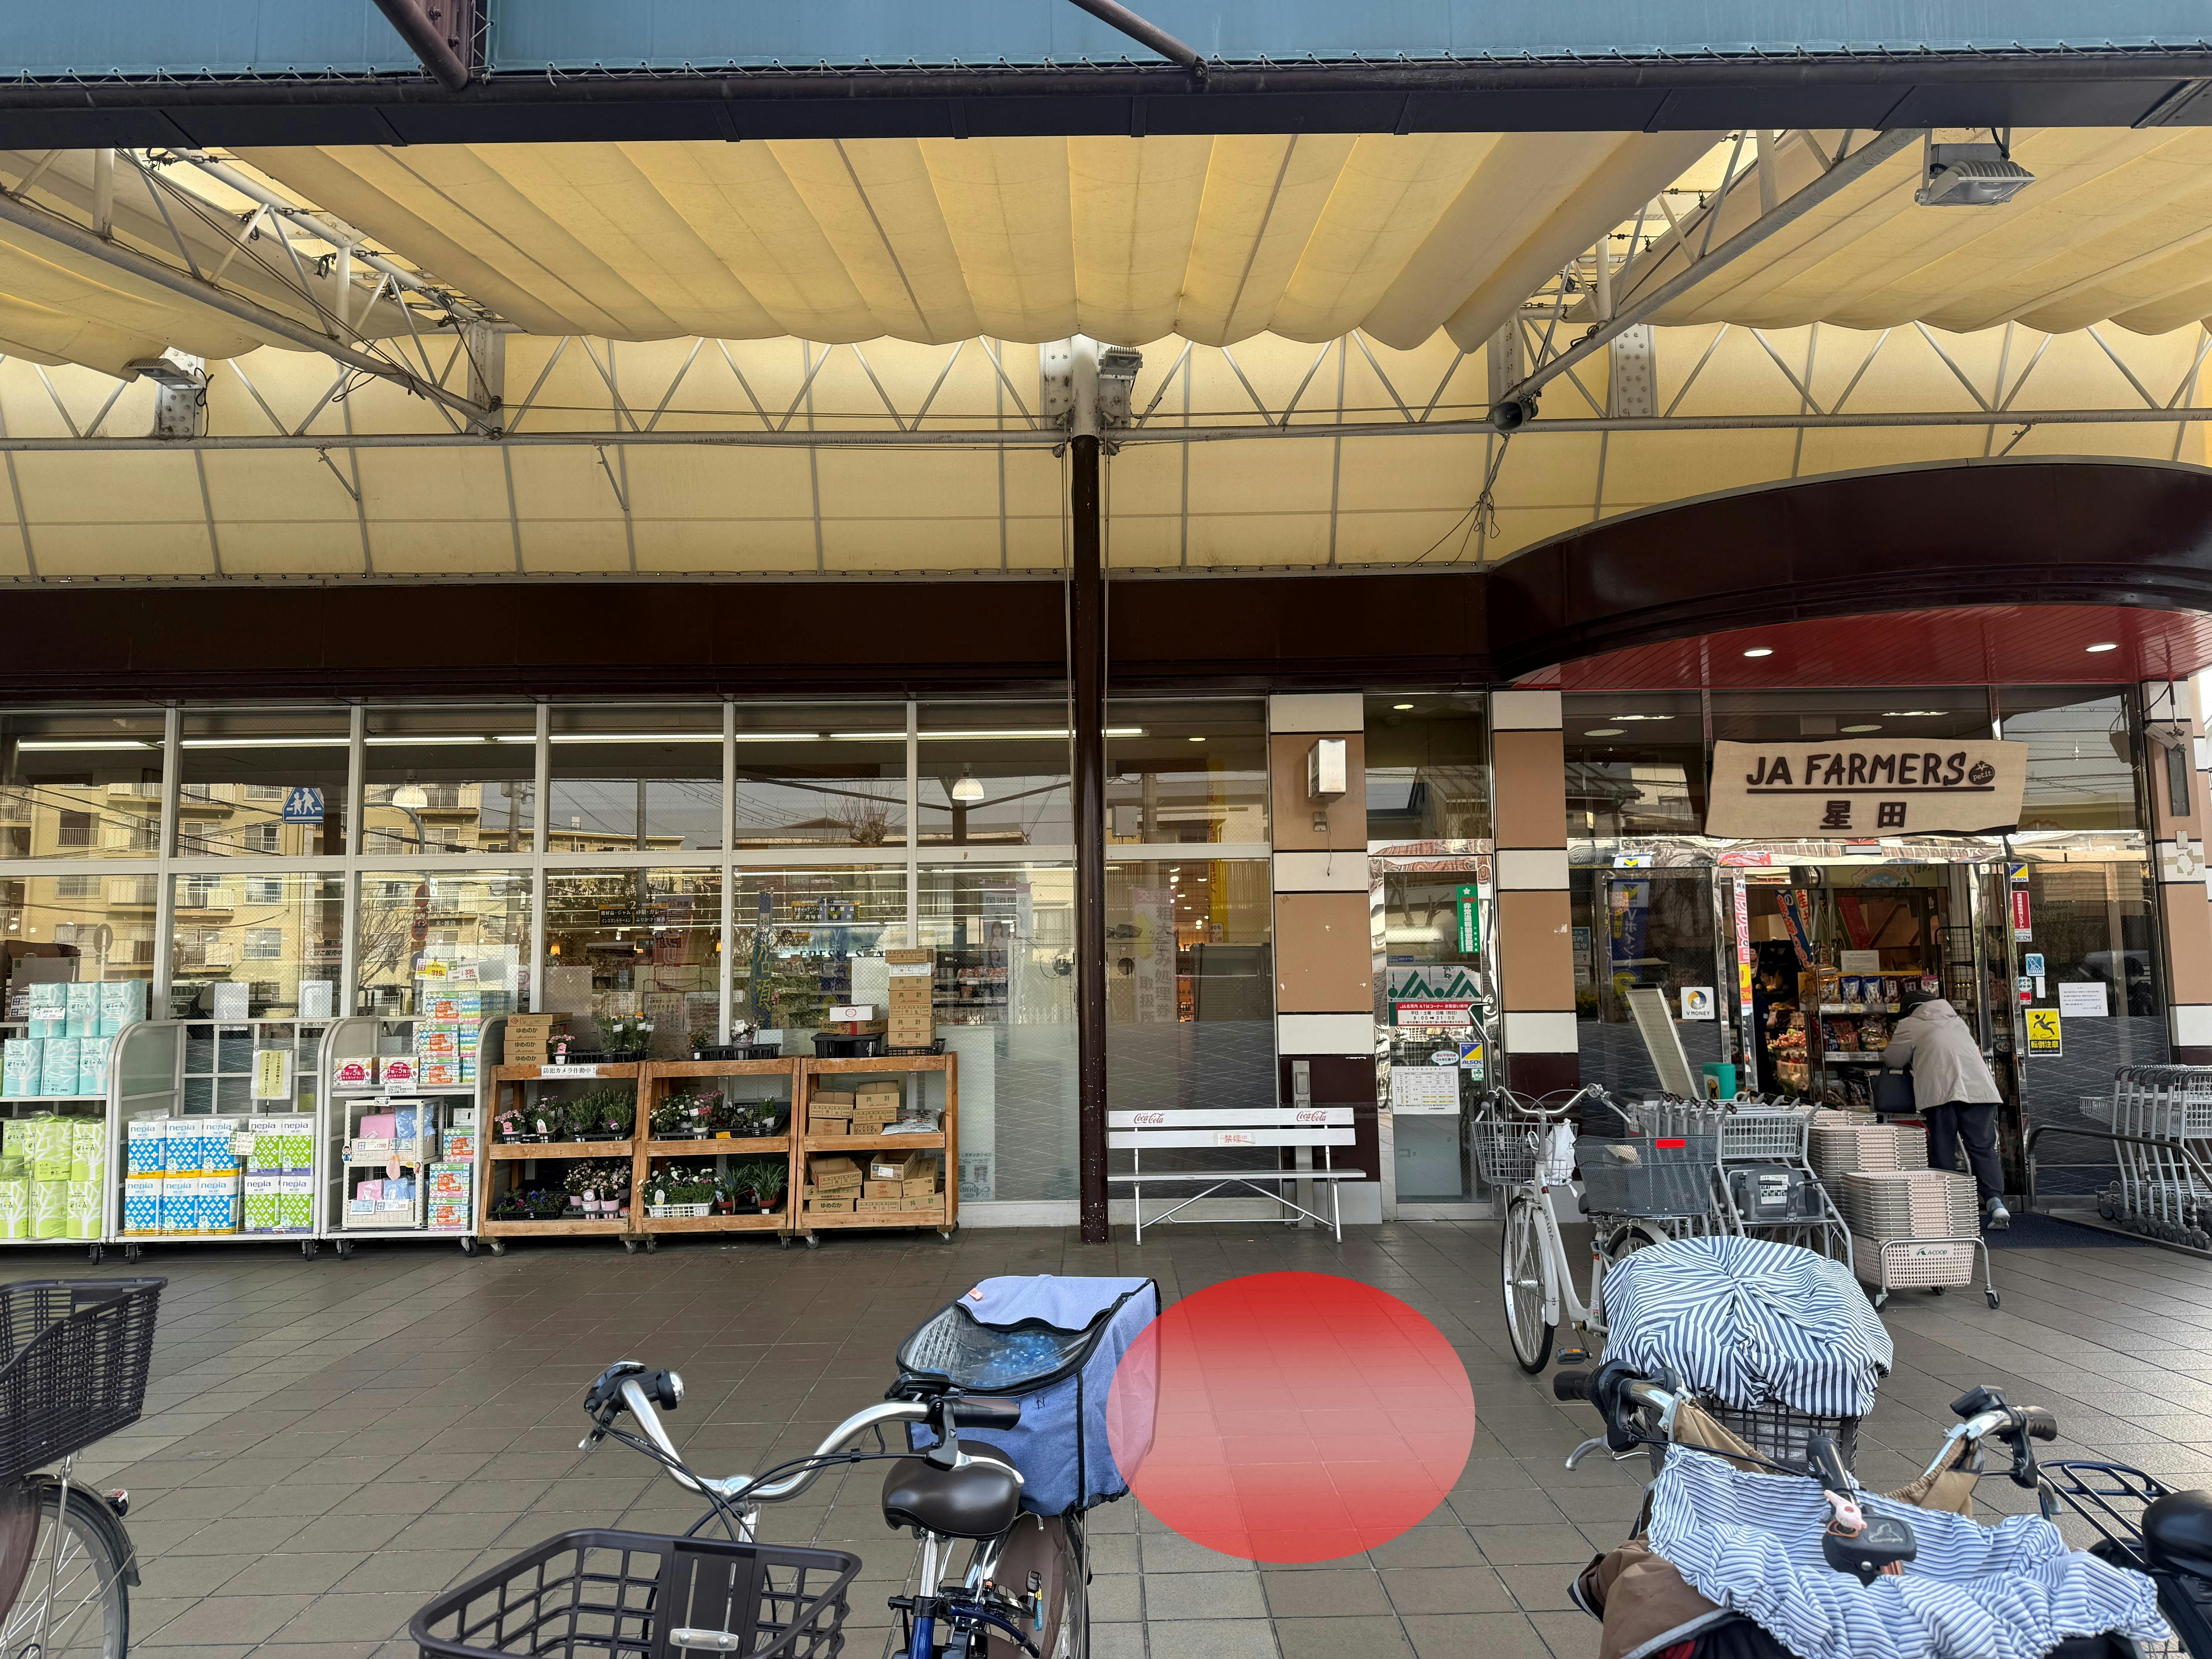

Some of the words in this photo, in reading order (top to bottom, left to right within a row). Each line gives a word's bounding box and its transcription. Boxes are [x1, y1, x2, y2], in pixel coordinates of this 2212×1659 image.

[1747, 757, 1793, 785] JA
[1805, 752, 1966, 786] FARMERS
[1973, 771, 1993, 781] petit
[1139, 890, 1172, 902] 交野市
[630, 901, 636, 909] 2
[2031, 1041, 2059, 1049] 転倒注意
[1134, 1112, 1165, 1124] Coca-Cola
[1296, 1110, 1328, 1122] Coca-Cola
[131, 1125, 155, 1133] nepia
[128, 1182, 153, 1190] nepia
[247, 1180, 271, 1188] nepia
